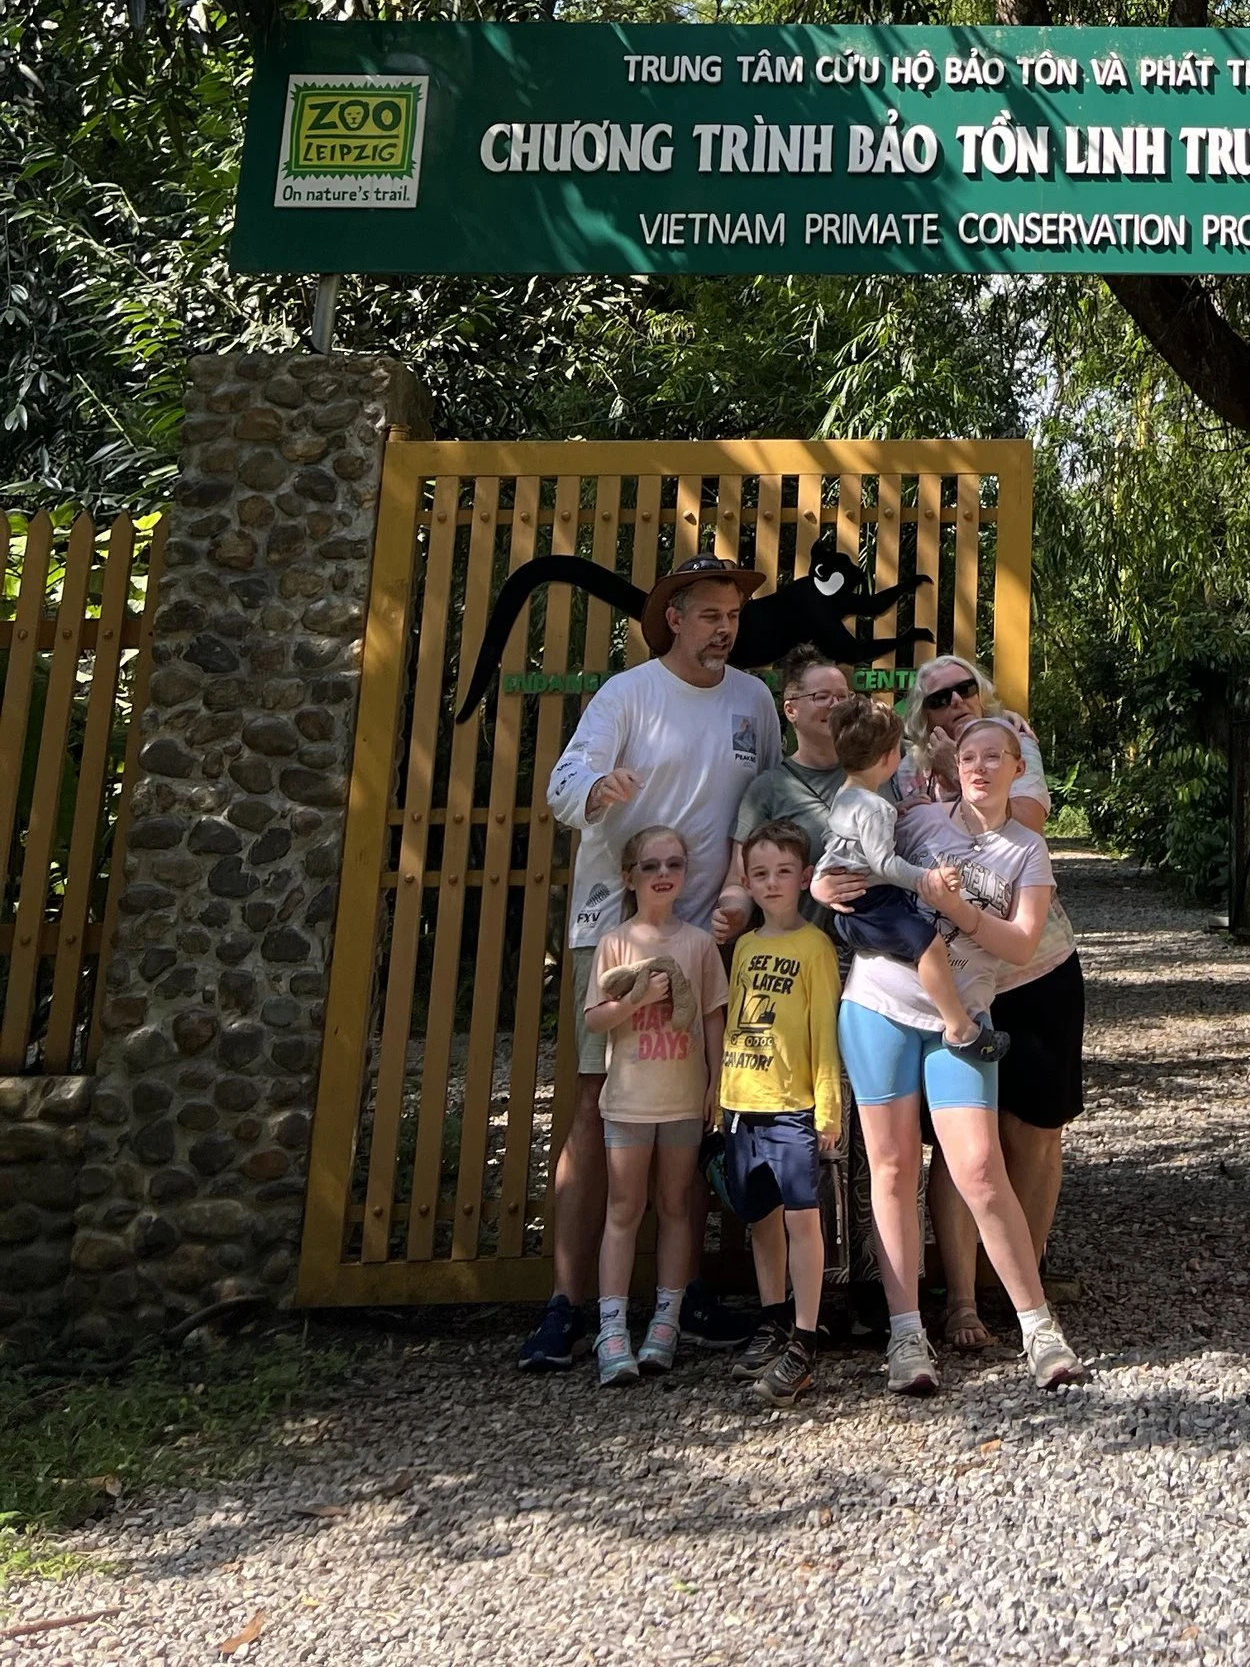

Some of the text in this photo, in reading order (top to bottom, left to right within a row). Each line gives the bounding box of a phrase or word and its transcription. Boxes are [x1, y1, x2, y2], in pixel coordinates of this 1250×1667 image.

[623, 55, 723, 83] TRUNG
[736, 48, 804, 83] TÂM
[816, 48, 880, 84] CỨU
[891, 49, 935, 91] HỘ
[945, 48, 1005, 85] BẢO
[1090, 52, 1128, 86] VÀ
[1140, 52, 1214, 87] PHÁT
[307, 99, 402, 131] ZOO
[303, 142, 398, 162] LEIPZIG
[480, 119, 674, 173] CHƯƠNG
[692, 115, 832, 173] TRÌNH
[847, 108, 938, 174] BẢO
[956, 109, 1050, 175] TỒN
[1065, 125, 1167, 175] LINH
[282, 185, 410, 202] On nature's trail.
[639, 213, 786, 246] VIETNAM
[805, 213, 940, 245] PRIMATE
[958, 212, 1186, 247] CONSERVATION
[748, 955, 800, 977] SEE YOU
[752, 973, 794, 994] LATER
[638, 1033, 689, 1060] DAYS
